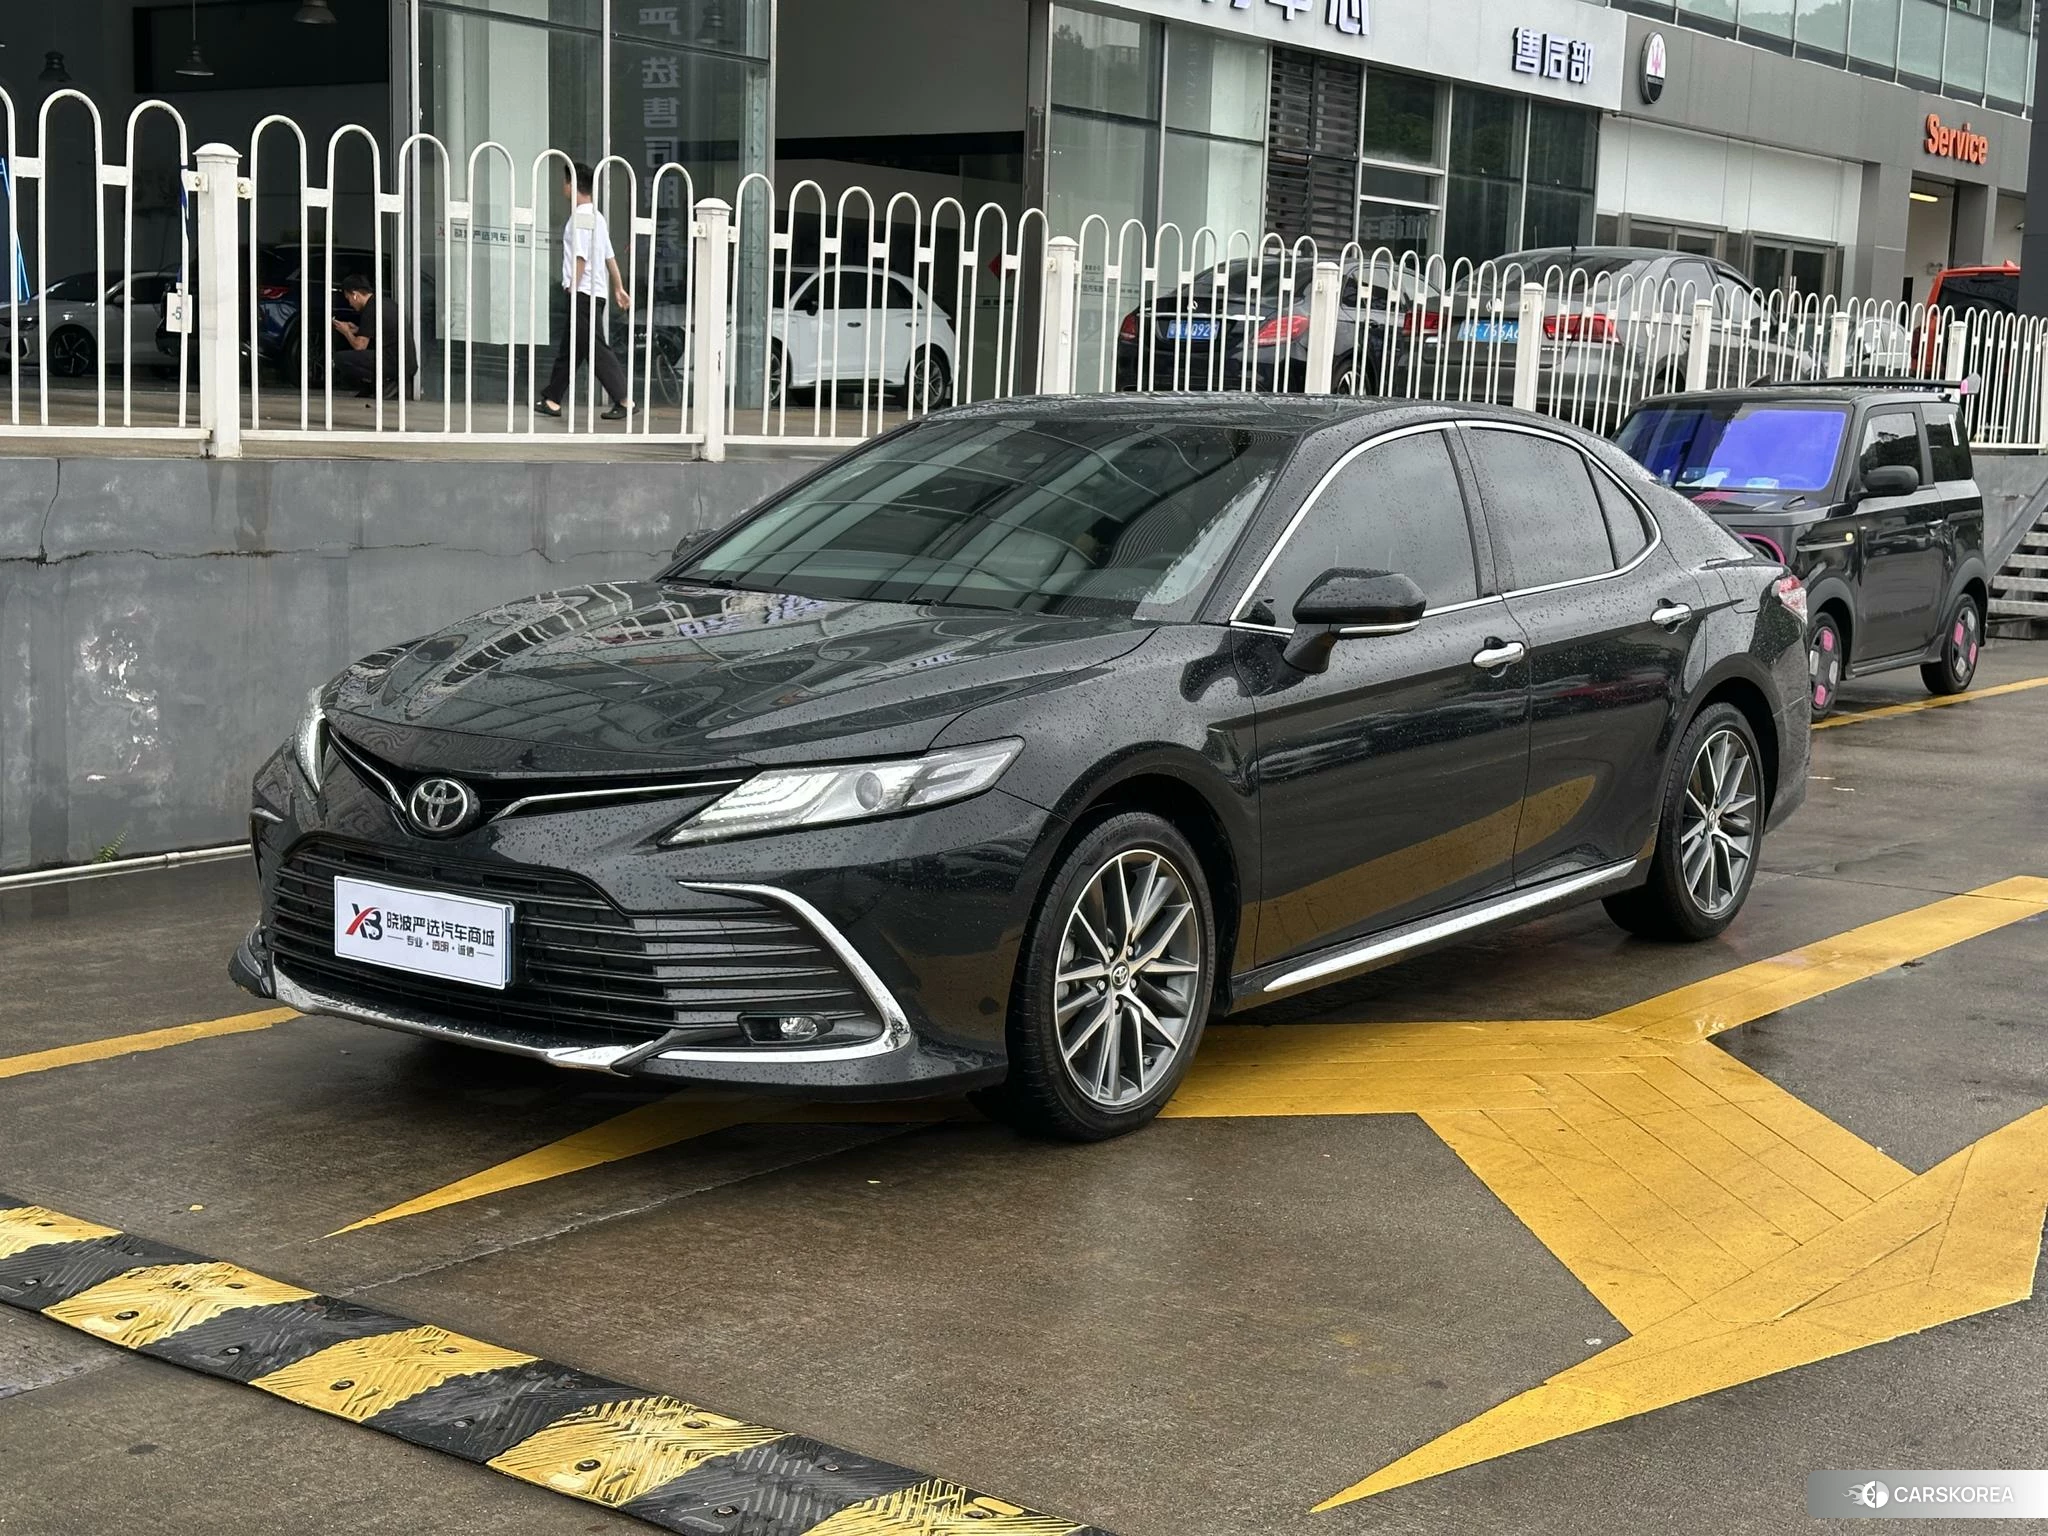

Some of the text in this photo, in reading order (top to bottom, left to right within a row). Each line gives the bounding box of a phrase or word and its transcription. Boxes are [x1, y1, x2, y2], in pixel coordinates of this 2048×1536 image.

[1513, 27, 1594, 84] 售后部
[1925, 113, 1988, 165] Service
[345, 902, 383, 941] XB
[386, 911, 495, 947] 晓波严选汽车商城
